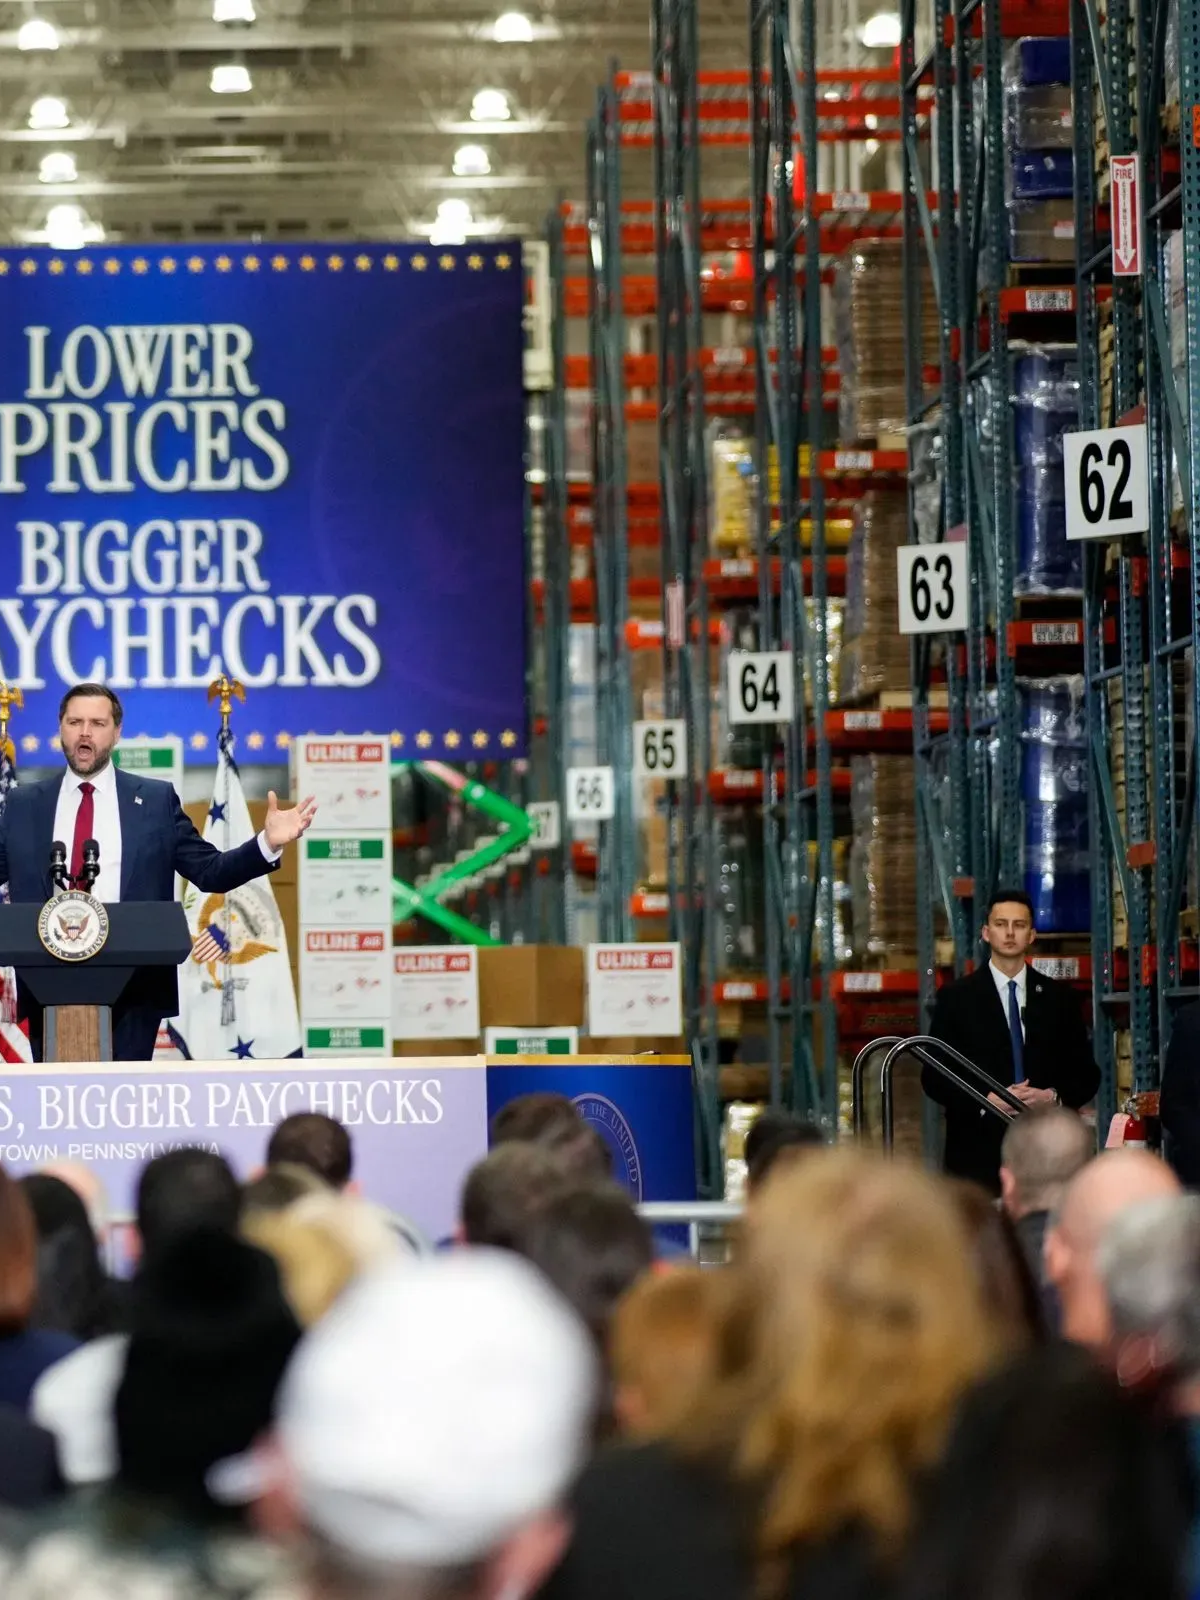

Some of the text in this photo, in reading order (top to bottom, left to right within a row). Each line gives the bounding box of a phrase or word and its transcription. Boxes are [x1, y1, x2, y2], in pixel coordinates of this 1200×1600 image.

[1115, 168, 1133, 180] FIRE
[24, 323, 260, 399] LOWER
[1079, 439, 1133, 524] 62
[15, 518, 270, 595] BIGGER
[910, 555, 955, 622] 63
[740, 662, 781, 712] 64
[308, 744, 357, 762] ULINE
[644, 729, 676, 770] 65
[577, 777, 603, 810] 66
[308, 932, 381, 950] ULINE AIR
[599, 951, 671, 968] ULINE AIR
[397, 954, 469, 972] ULINE AIR
[37, 1083, 196, 1131] BIGGER
[205, 1079, 443, 1127] PAYCHECKS
[68, 1142, 220, 1161] PENNSYLVA
[589, 1102, 608, 1119] THE
[610, 1113, 639, 1182] UNITED
